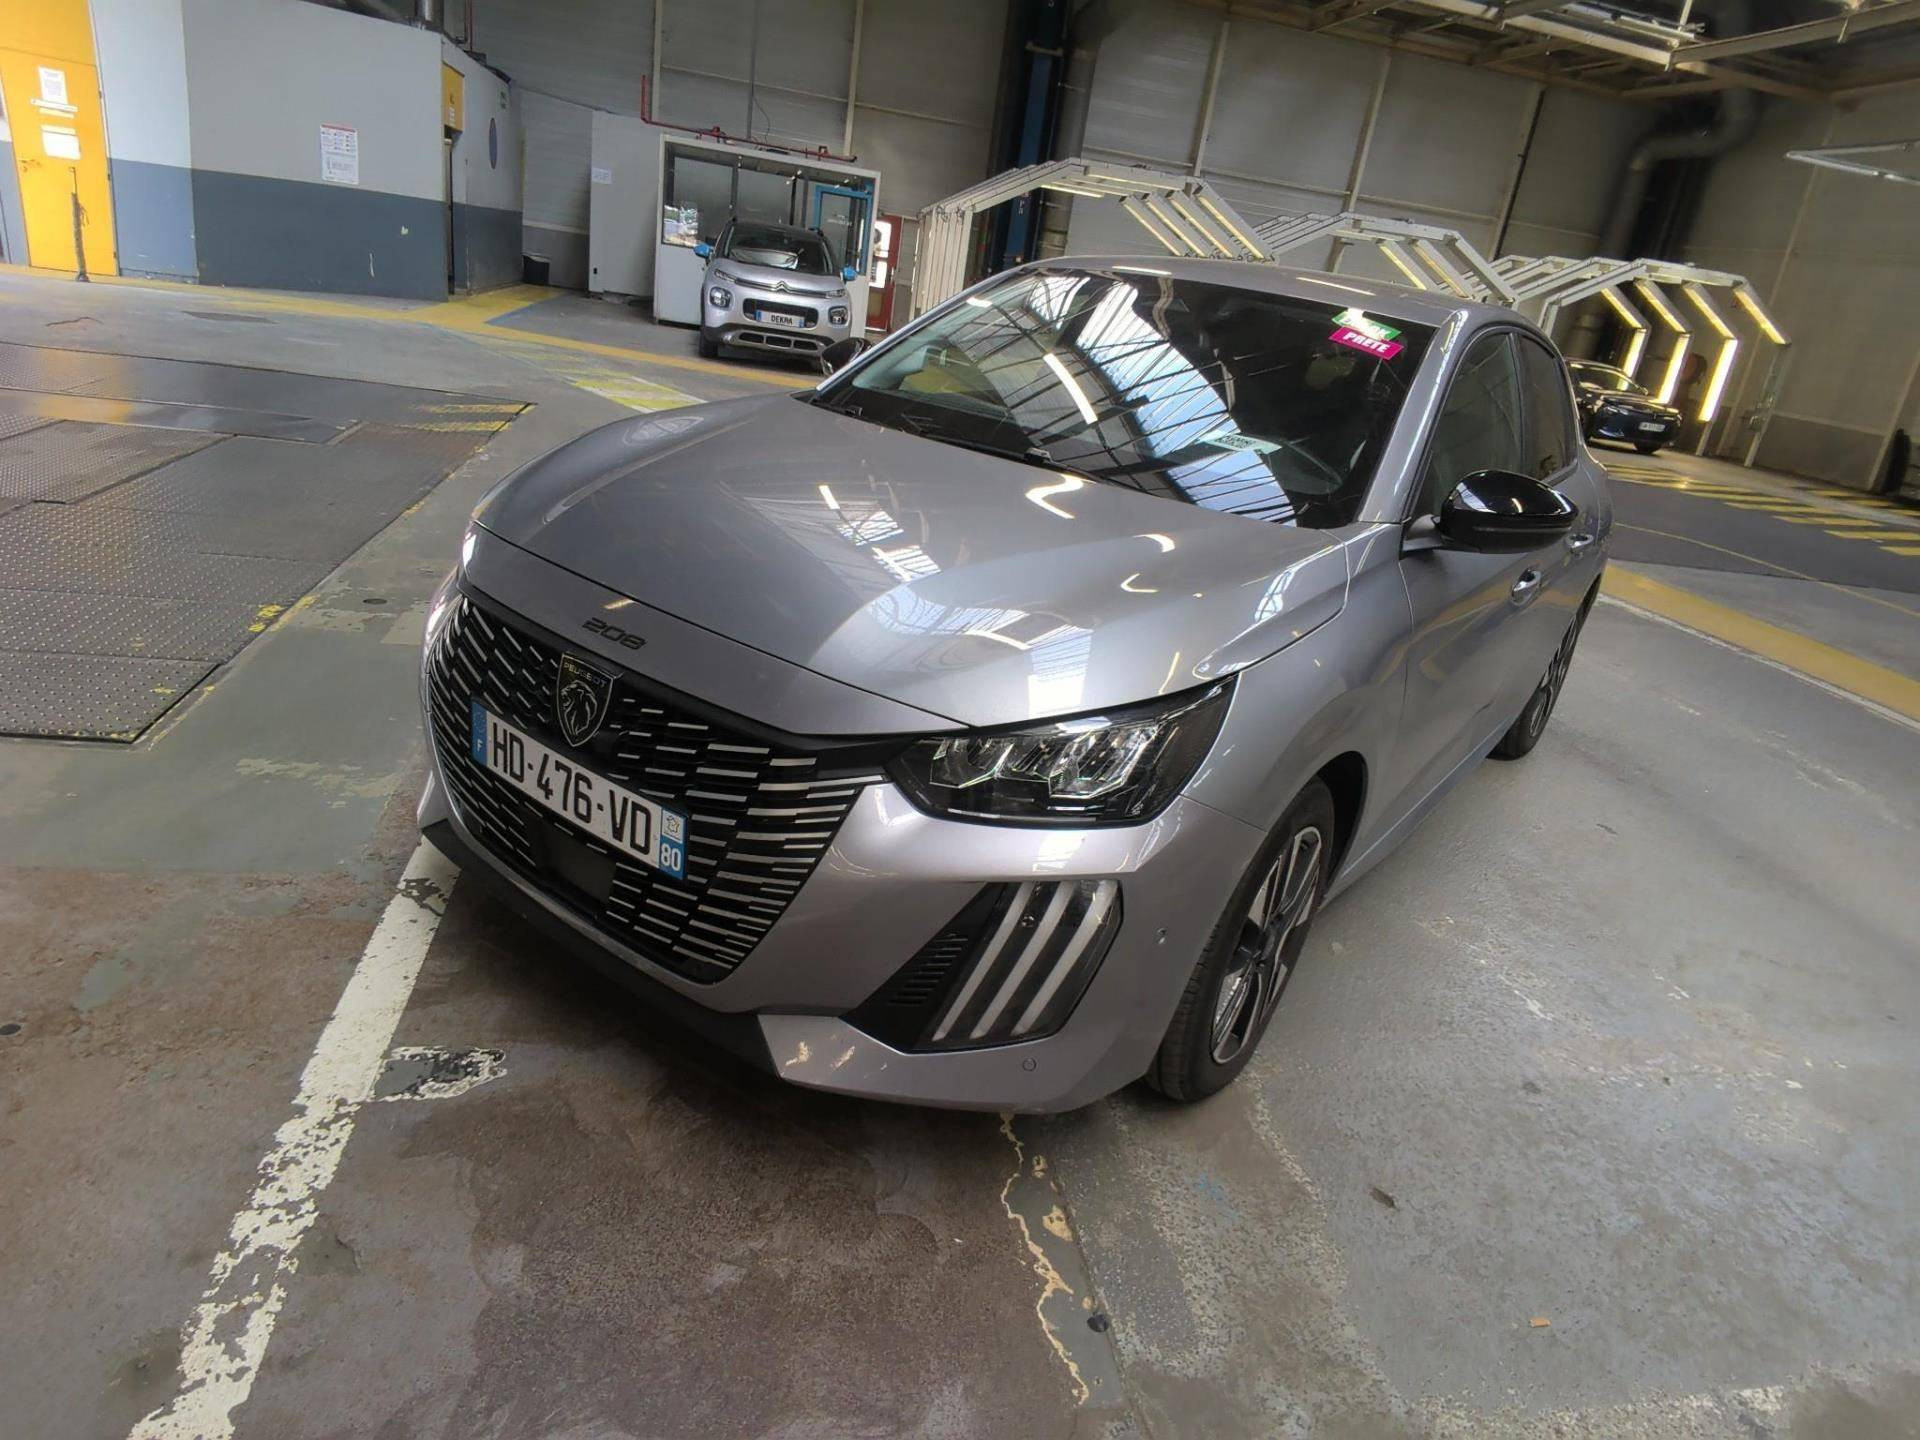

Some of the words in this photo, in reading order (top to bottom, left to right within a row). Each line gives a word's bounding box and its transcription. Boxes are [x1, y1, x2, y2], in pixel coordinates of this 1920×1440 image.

[771, 314, 793, 325] DEKRA
[581, 617, 646, 650] 208
[563, 662, 608, 688] PEUGEOT
[477, 738, 483, 752] F
[493, 722, 651, 855] HD-476-VD
[661, 843, 681, 871] 80
